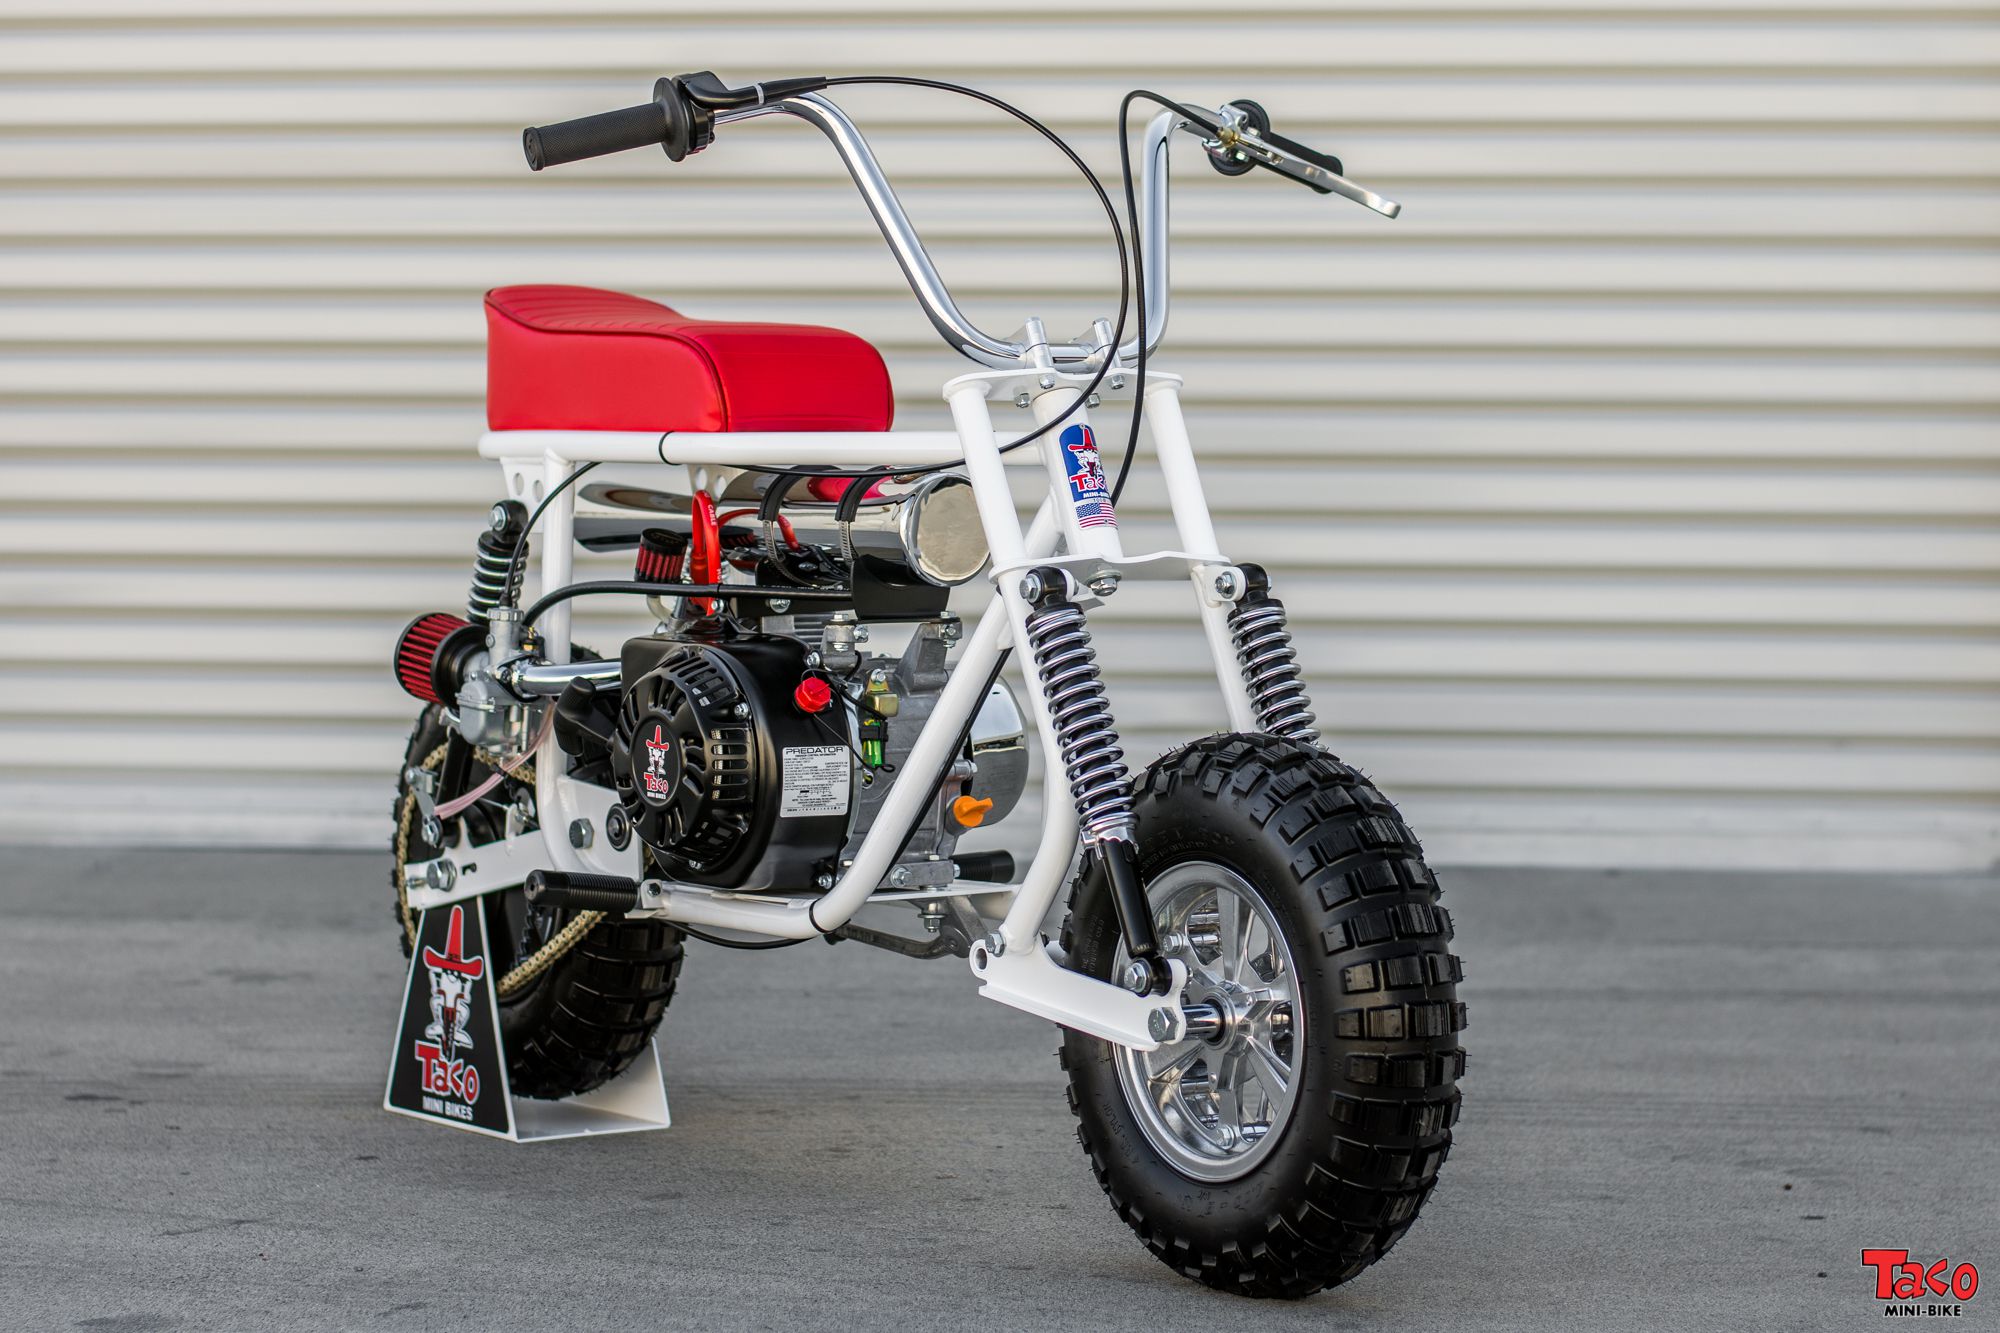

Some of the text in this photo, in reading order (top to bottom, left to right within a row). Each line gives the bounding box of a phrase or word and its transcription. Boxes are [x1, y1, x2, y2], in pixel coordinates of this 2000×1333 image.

[1070, 473, 1107, 492] Tac
[708, 504, 717, 526] CABLE
[786, 746, 844, 755] PREDATOR
[415, 1040, 480, 1104] Taco
[422, 1095, 473, 1121] MINI BIKES
